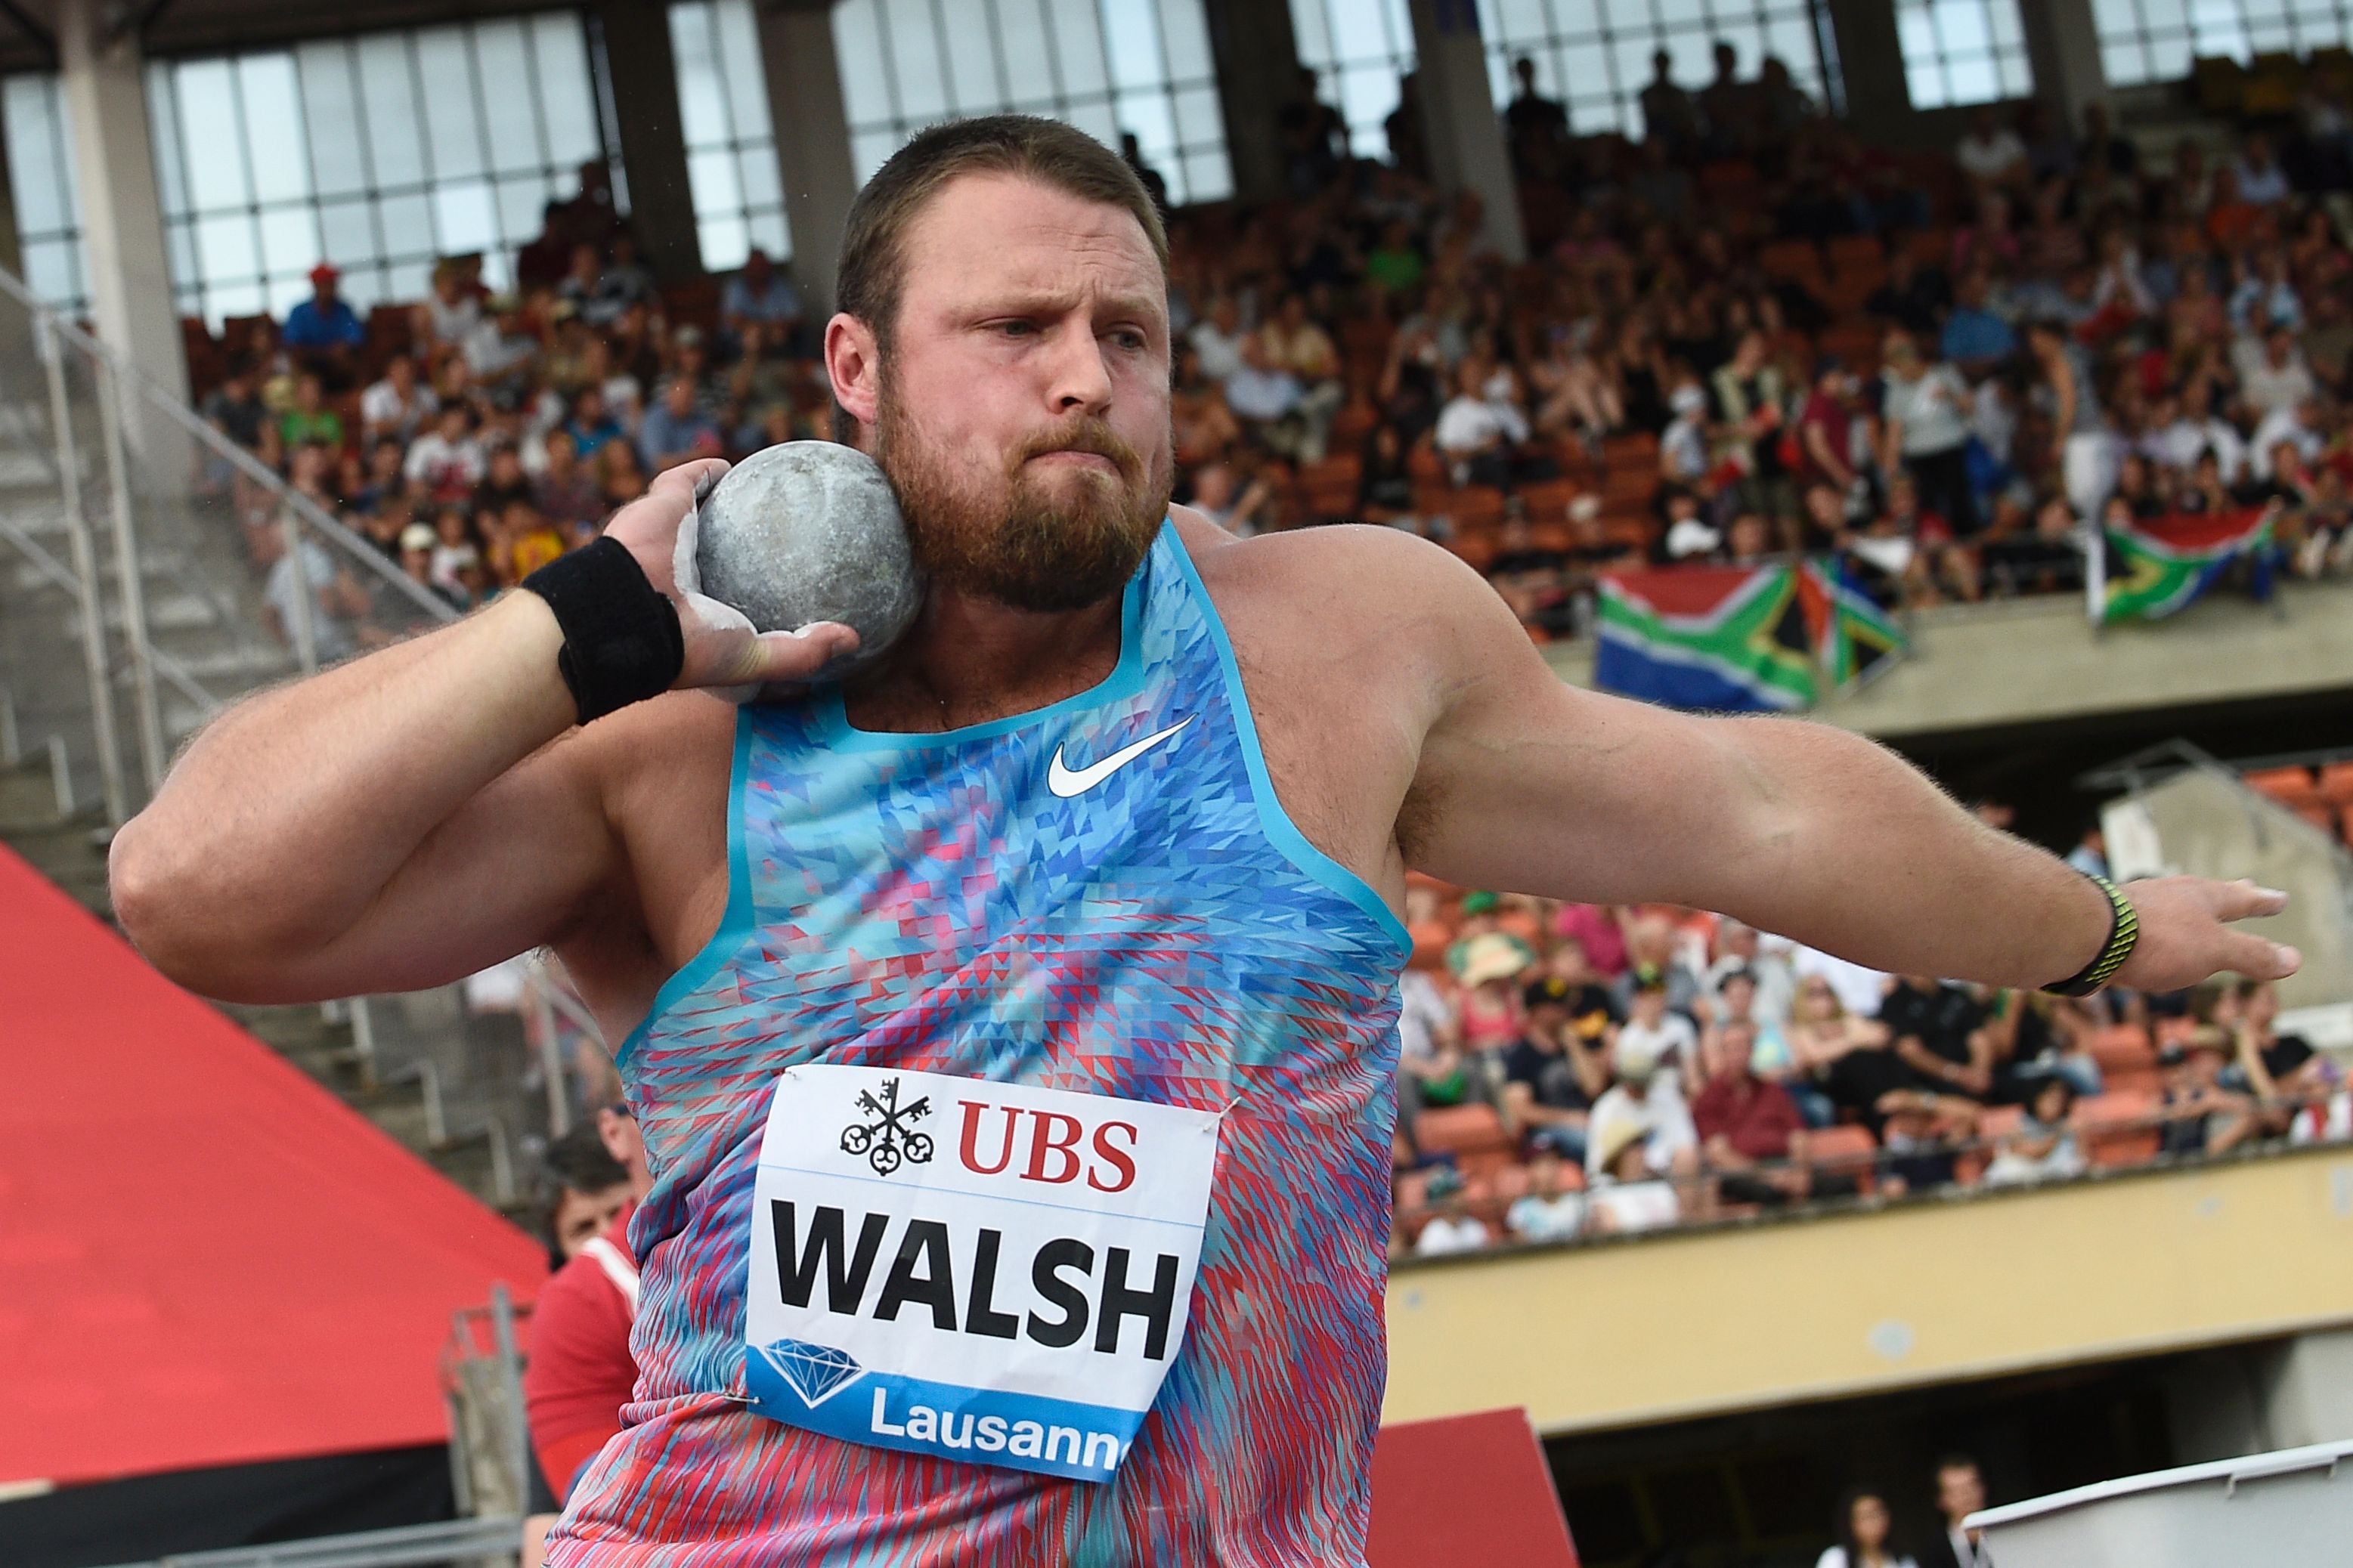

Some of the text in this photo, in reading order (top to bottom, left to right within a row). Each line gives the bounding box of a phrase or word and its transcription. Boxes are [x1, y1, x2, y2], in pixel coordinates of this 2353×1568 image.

[957, 1099, 1138, 1193] UBS
[770, 1198, 1180, 1361] WALSH
[870, 1387, 1132, 1471] Lausann
